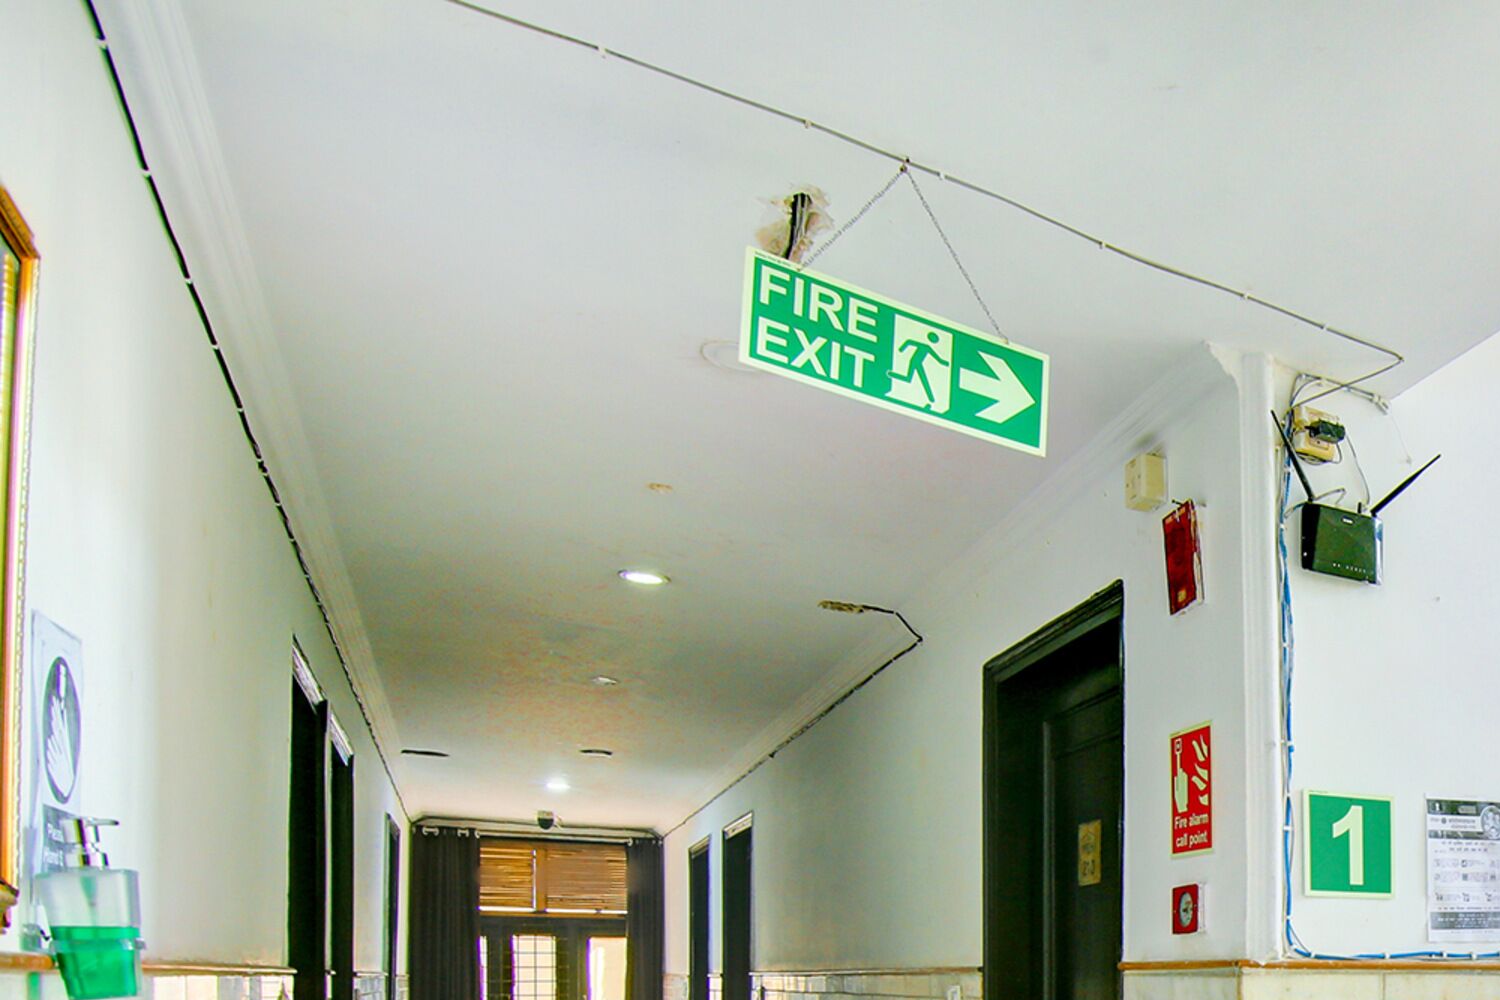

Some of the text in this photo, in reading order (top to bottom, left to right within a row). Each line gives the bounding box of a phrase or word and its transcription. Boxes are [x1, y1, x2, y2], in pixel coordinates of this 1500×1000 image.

[759, 264, 879, 342] FIRE
[756, 315, 875, 388] EXIT
[1175, 813, 1209, 829] Fire alarm
[1176, 830, 1208, 847] call point
[1332, 804, 1364, 885] 1
